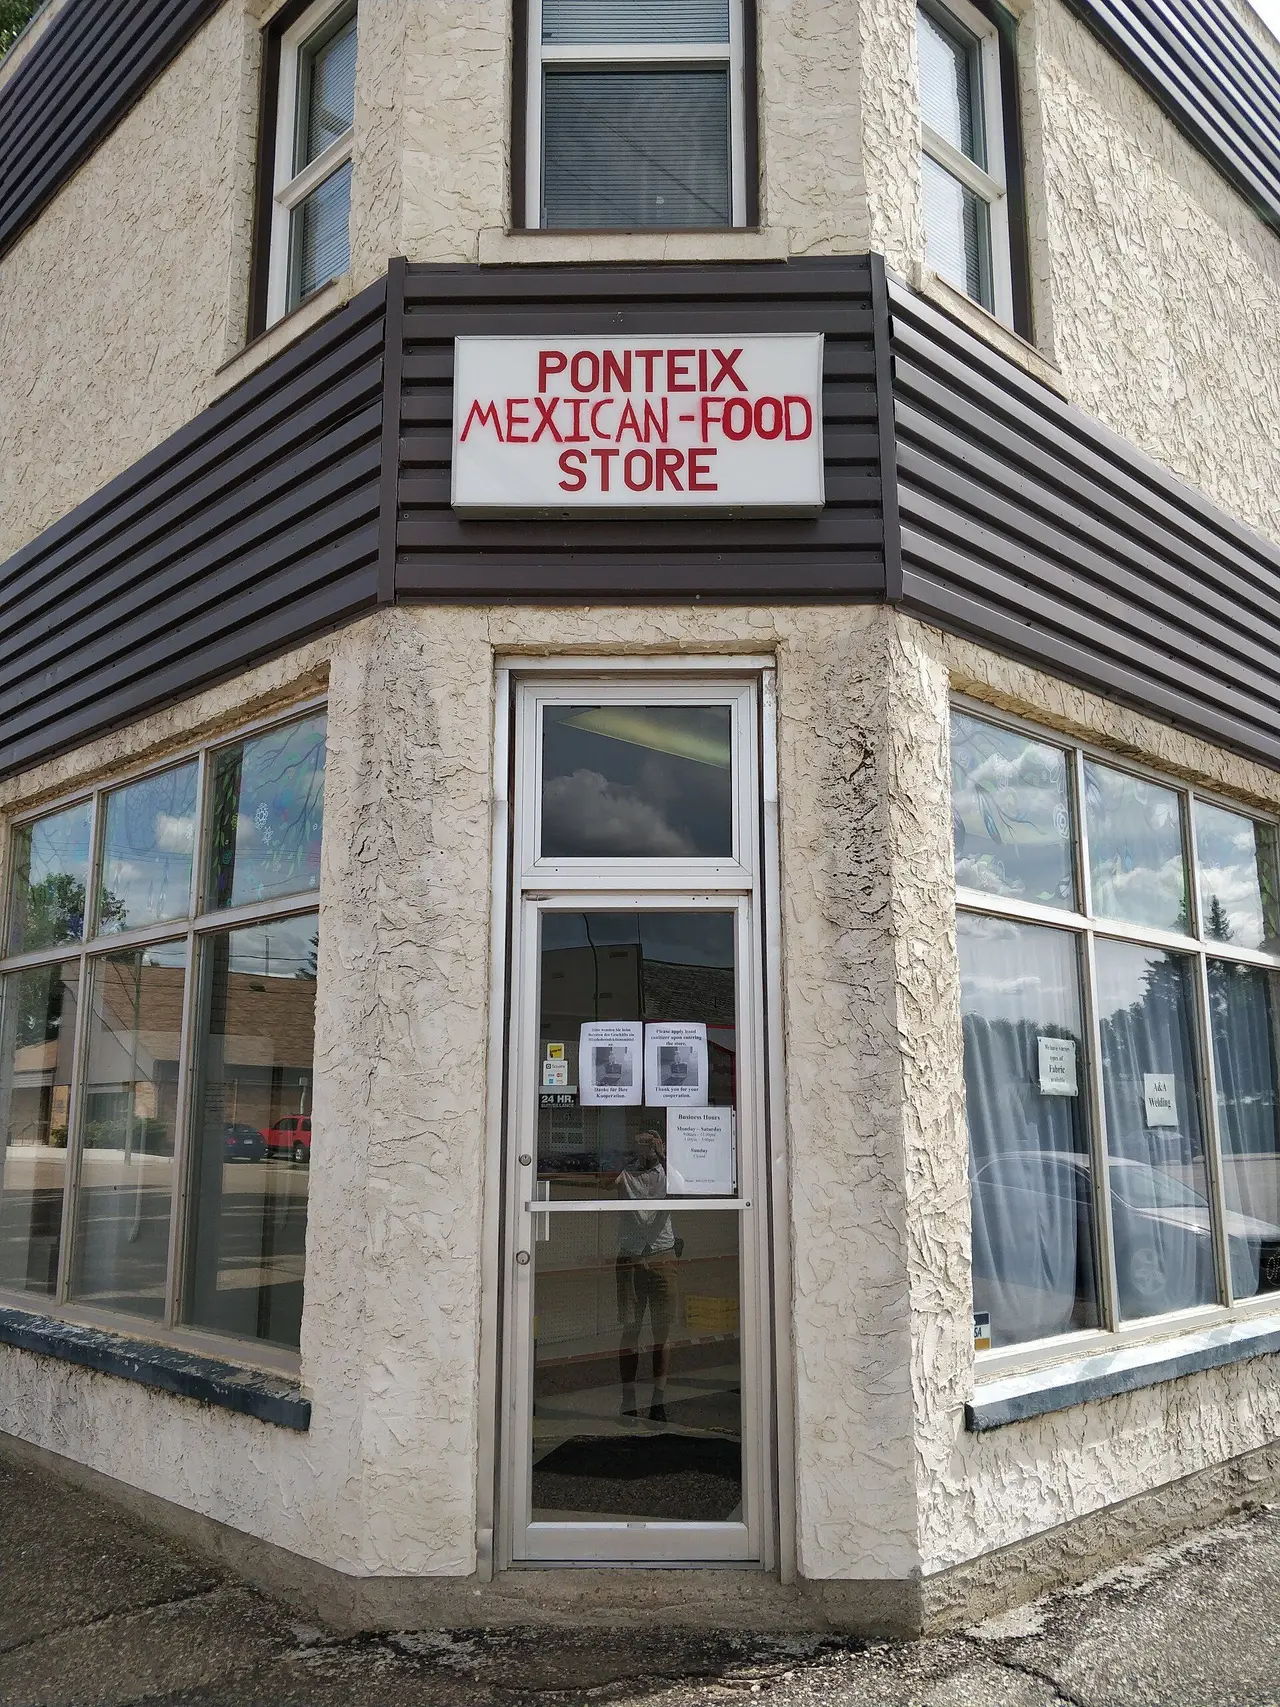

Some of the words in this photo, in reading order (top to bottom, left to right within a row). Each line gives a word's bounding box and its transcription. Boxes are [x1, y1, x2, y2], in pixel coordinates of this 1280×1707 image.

[538, 348, 748, 393] PONTEIX
[558, 447, 718, 492] STORE
[1049, 1064, 1065, 1073] Fabric
[1153, 1082, 1167, 1092] A&A
[541, 1095, 554, 1103] 24
[557, 1095, 574, 1103] HR.
[1148, 1097, 1171, 1110] Welding
